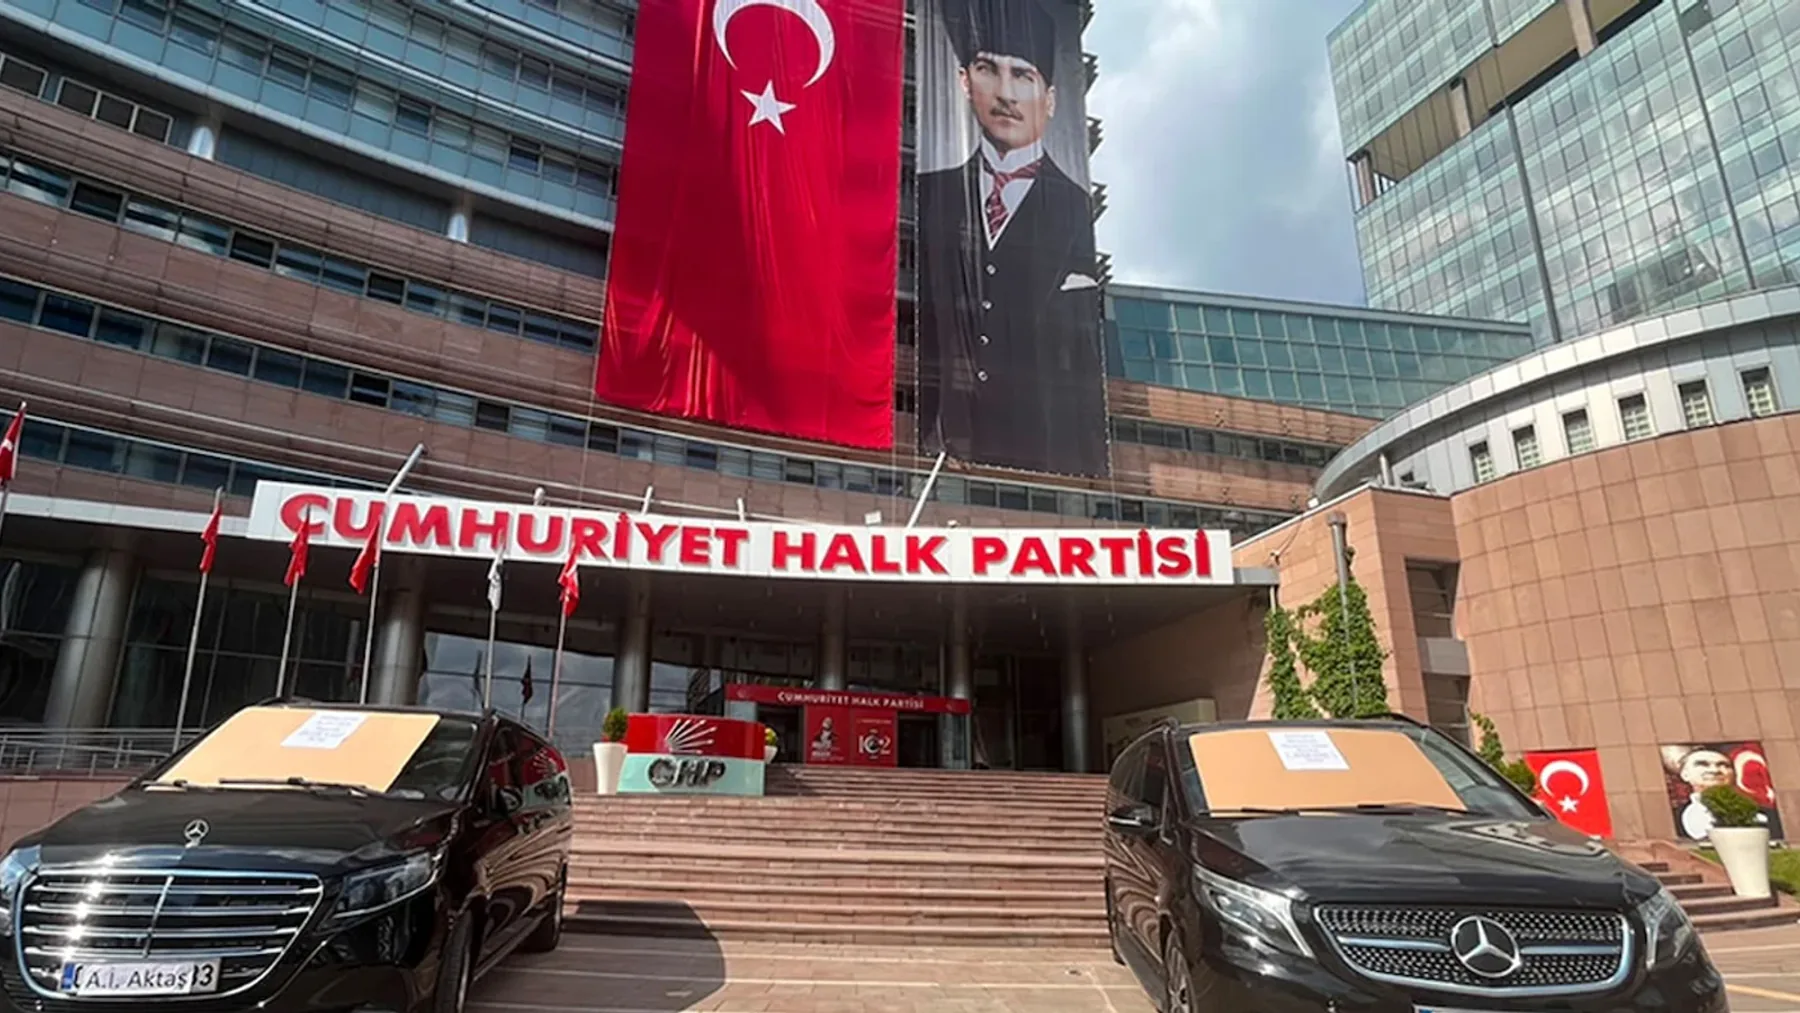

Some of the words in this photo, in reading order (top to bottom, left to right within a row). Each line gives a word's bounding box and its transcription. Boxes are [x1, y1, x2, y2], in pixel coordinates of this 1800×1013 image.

[280, 493, 750, 568] CUMHURİYET
[772, 531, 948, 575] HALK
[973, 528, 1212, 578] PARTİSİ
[777, 691, 849, 705] CUMHURİYET
[851, 696, 881, 707] HALK
[647, 757, 727, 788] CHP
[127, 968, 189, 989] Aktaş
